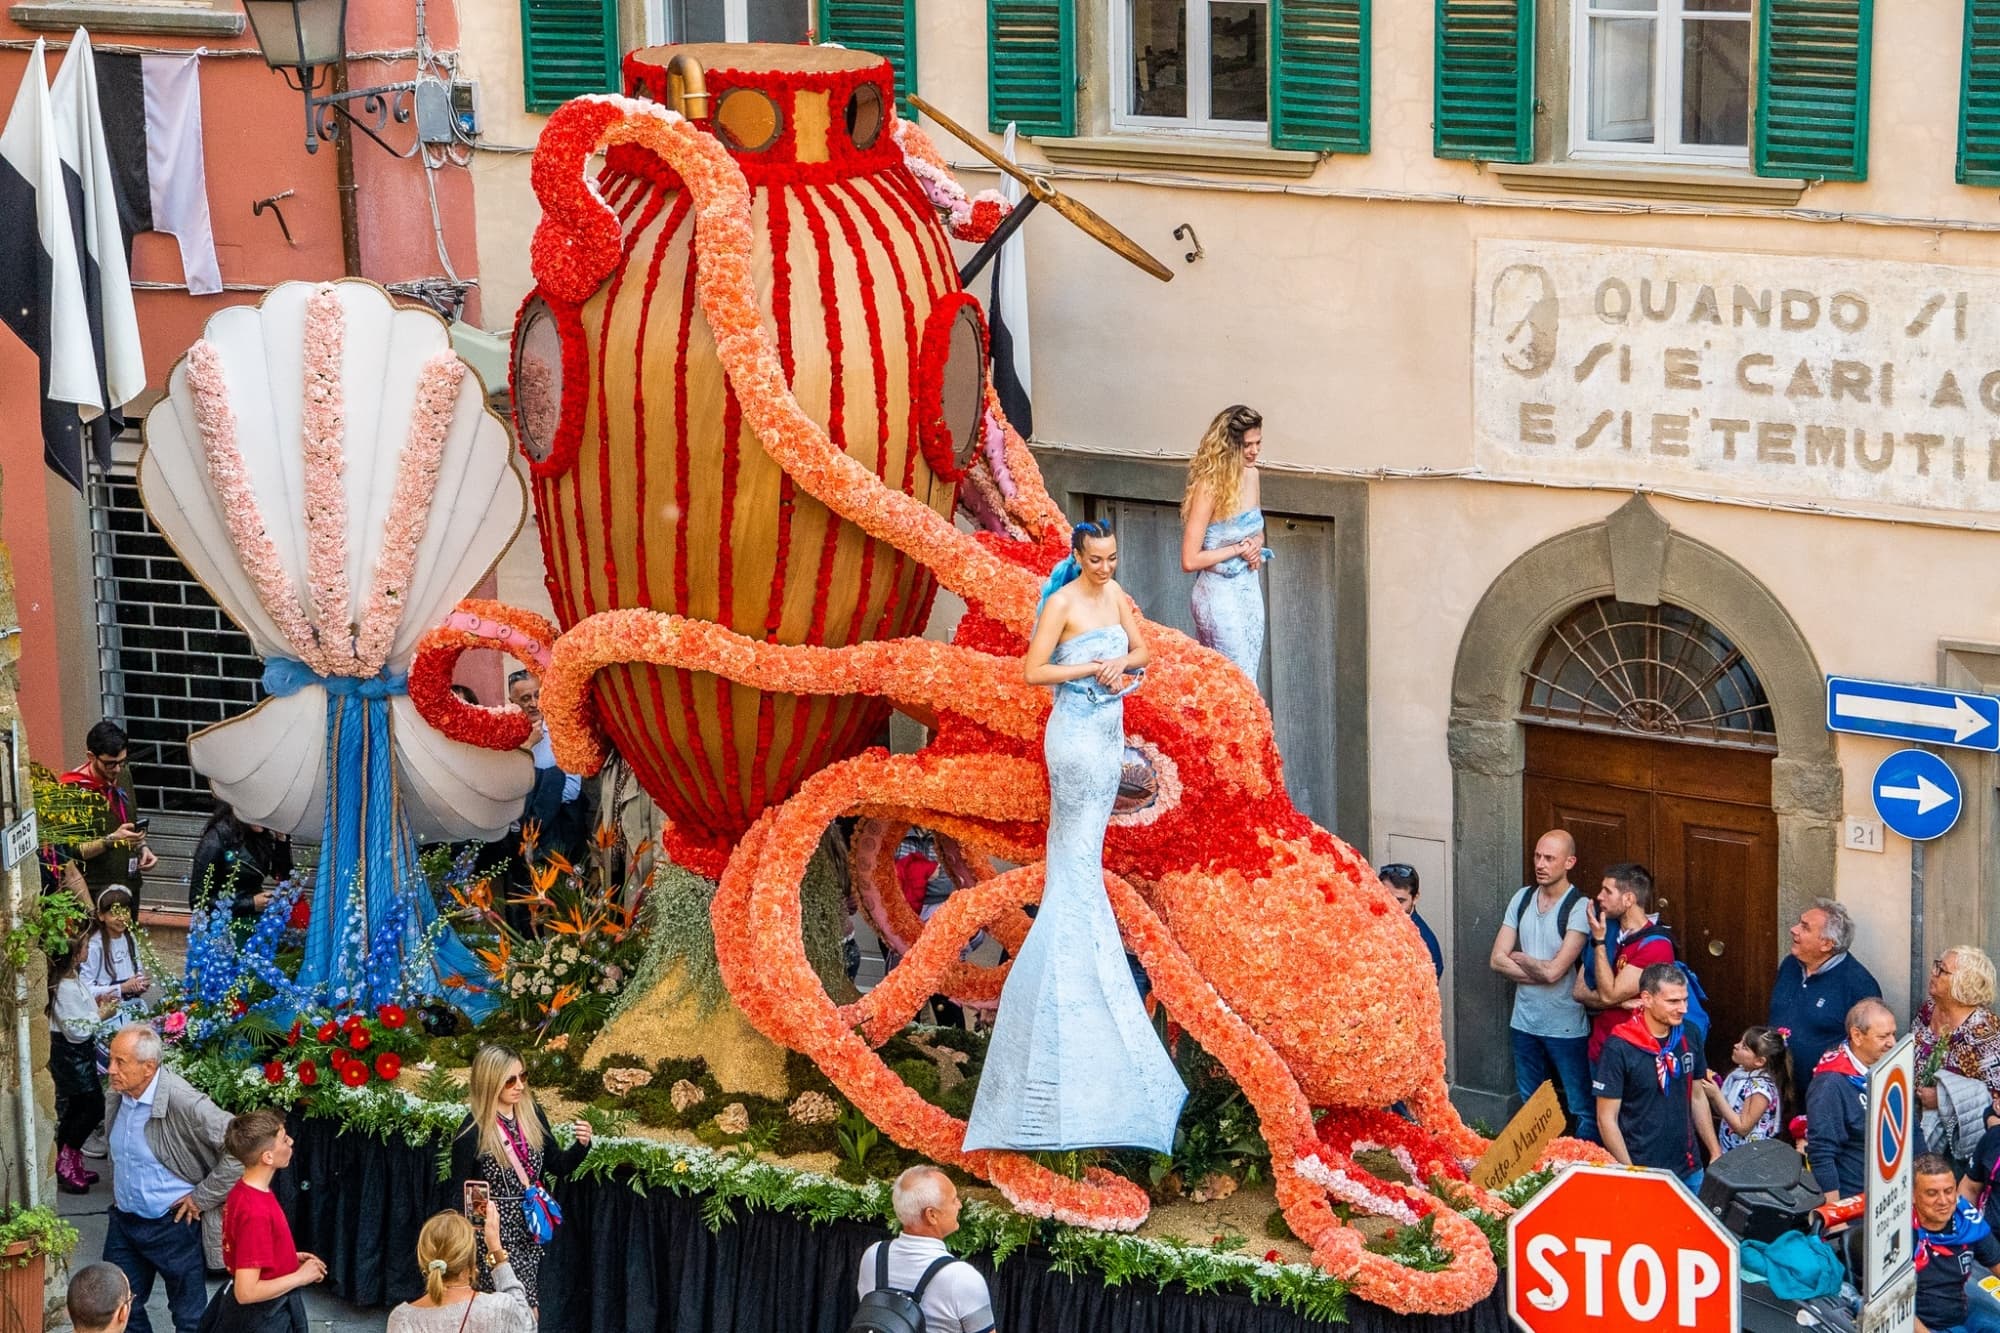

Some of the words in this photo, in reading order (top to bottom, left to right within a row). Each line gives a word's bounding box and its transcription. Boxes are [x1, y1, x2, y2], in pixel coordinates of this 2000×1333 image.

[1594, 276, 1869, 333] QUANDO
[1736, 353, 1893, 407] CARI
[1519, 402, 1556, 445] E
[1710, 418, 1966, 481] TEMUTI
[12, 822, 31, 845] ambo
[1854, 826, 1874, 846] 21
[1875, 1186, 1898, 1219] sabato
[1525, 1233, 1721, 1328] STOP
